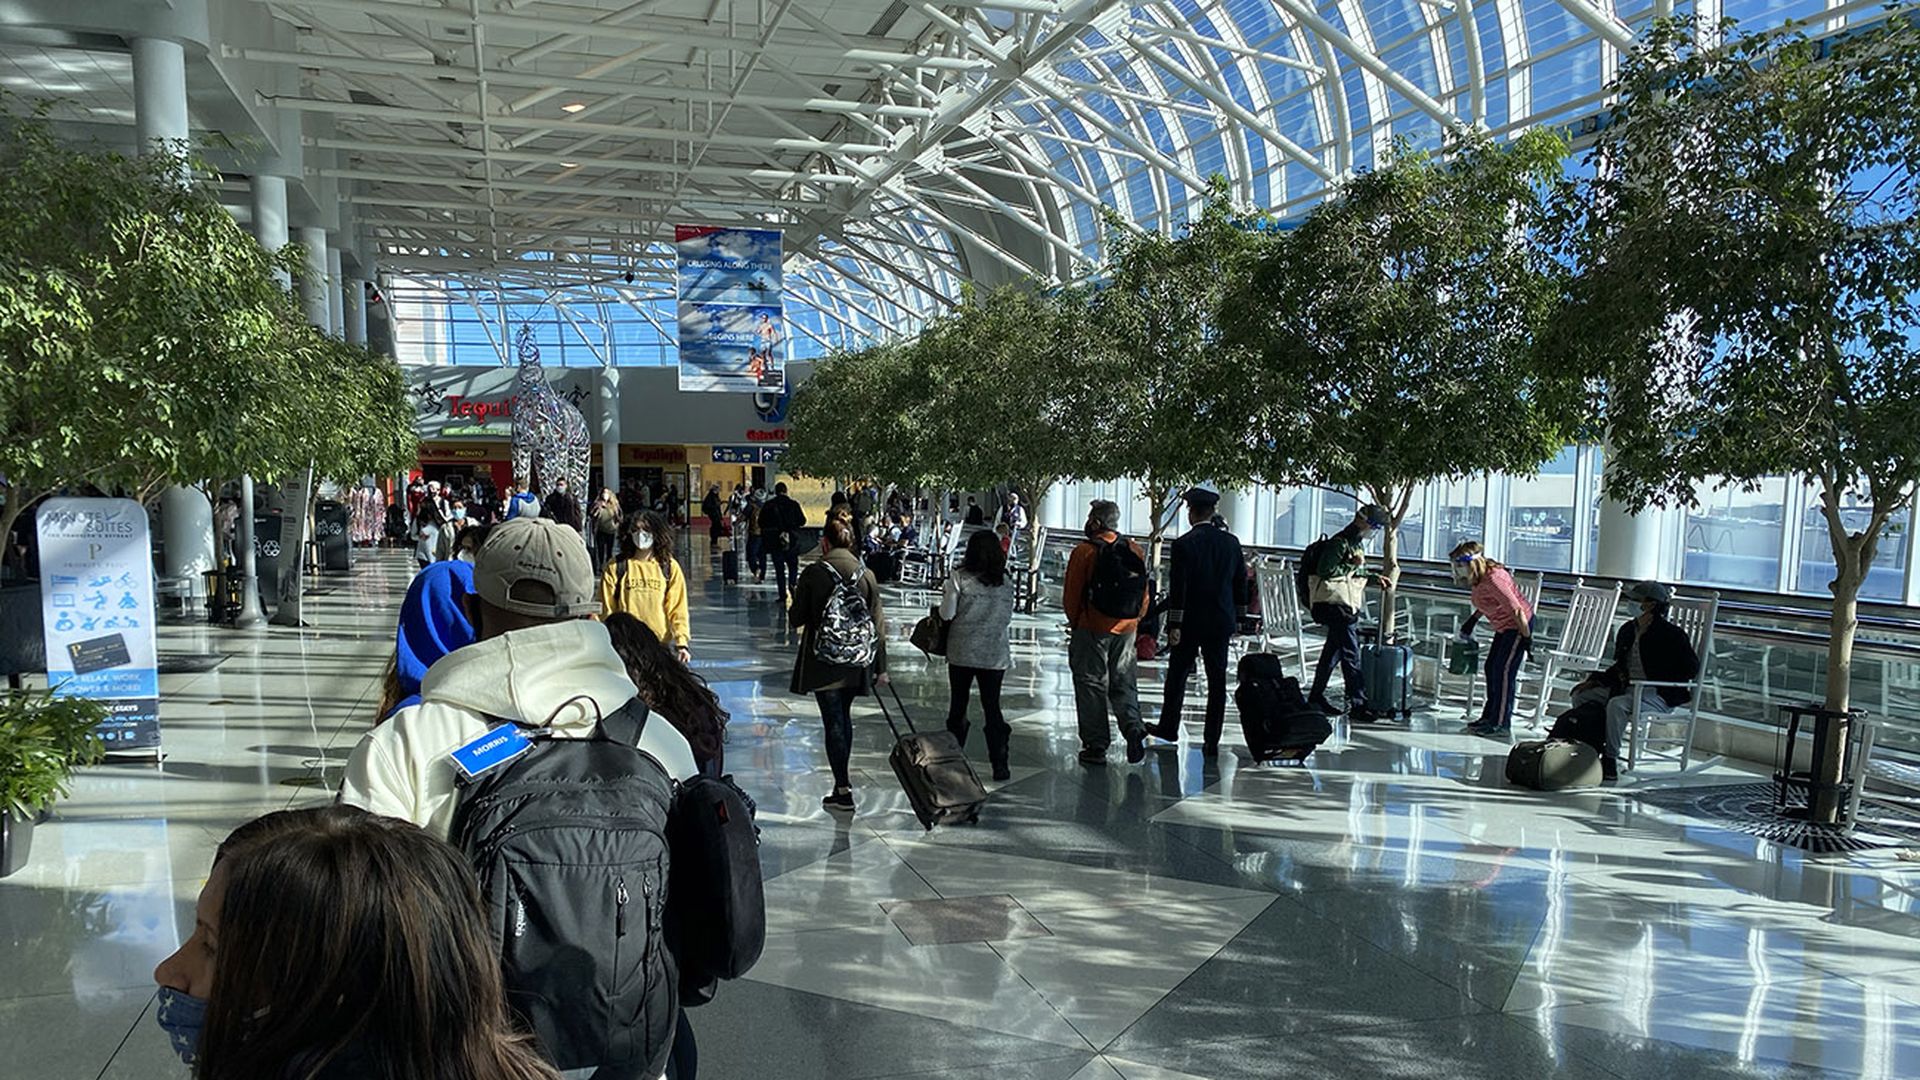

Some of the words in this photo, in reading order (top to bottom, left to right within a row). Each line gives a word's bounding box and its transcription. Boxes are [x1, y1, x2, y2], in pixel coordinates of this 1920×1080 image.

[687, 260, 722, 268] CRUISING
[724, 261, 749, 269] ALONG
[750, 262, 772, 270] THERE
[86, 522, 133, 533] SUITES
[90, 544, 102, 560] P
[472, 735, 508, 757] MORRIS
